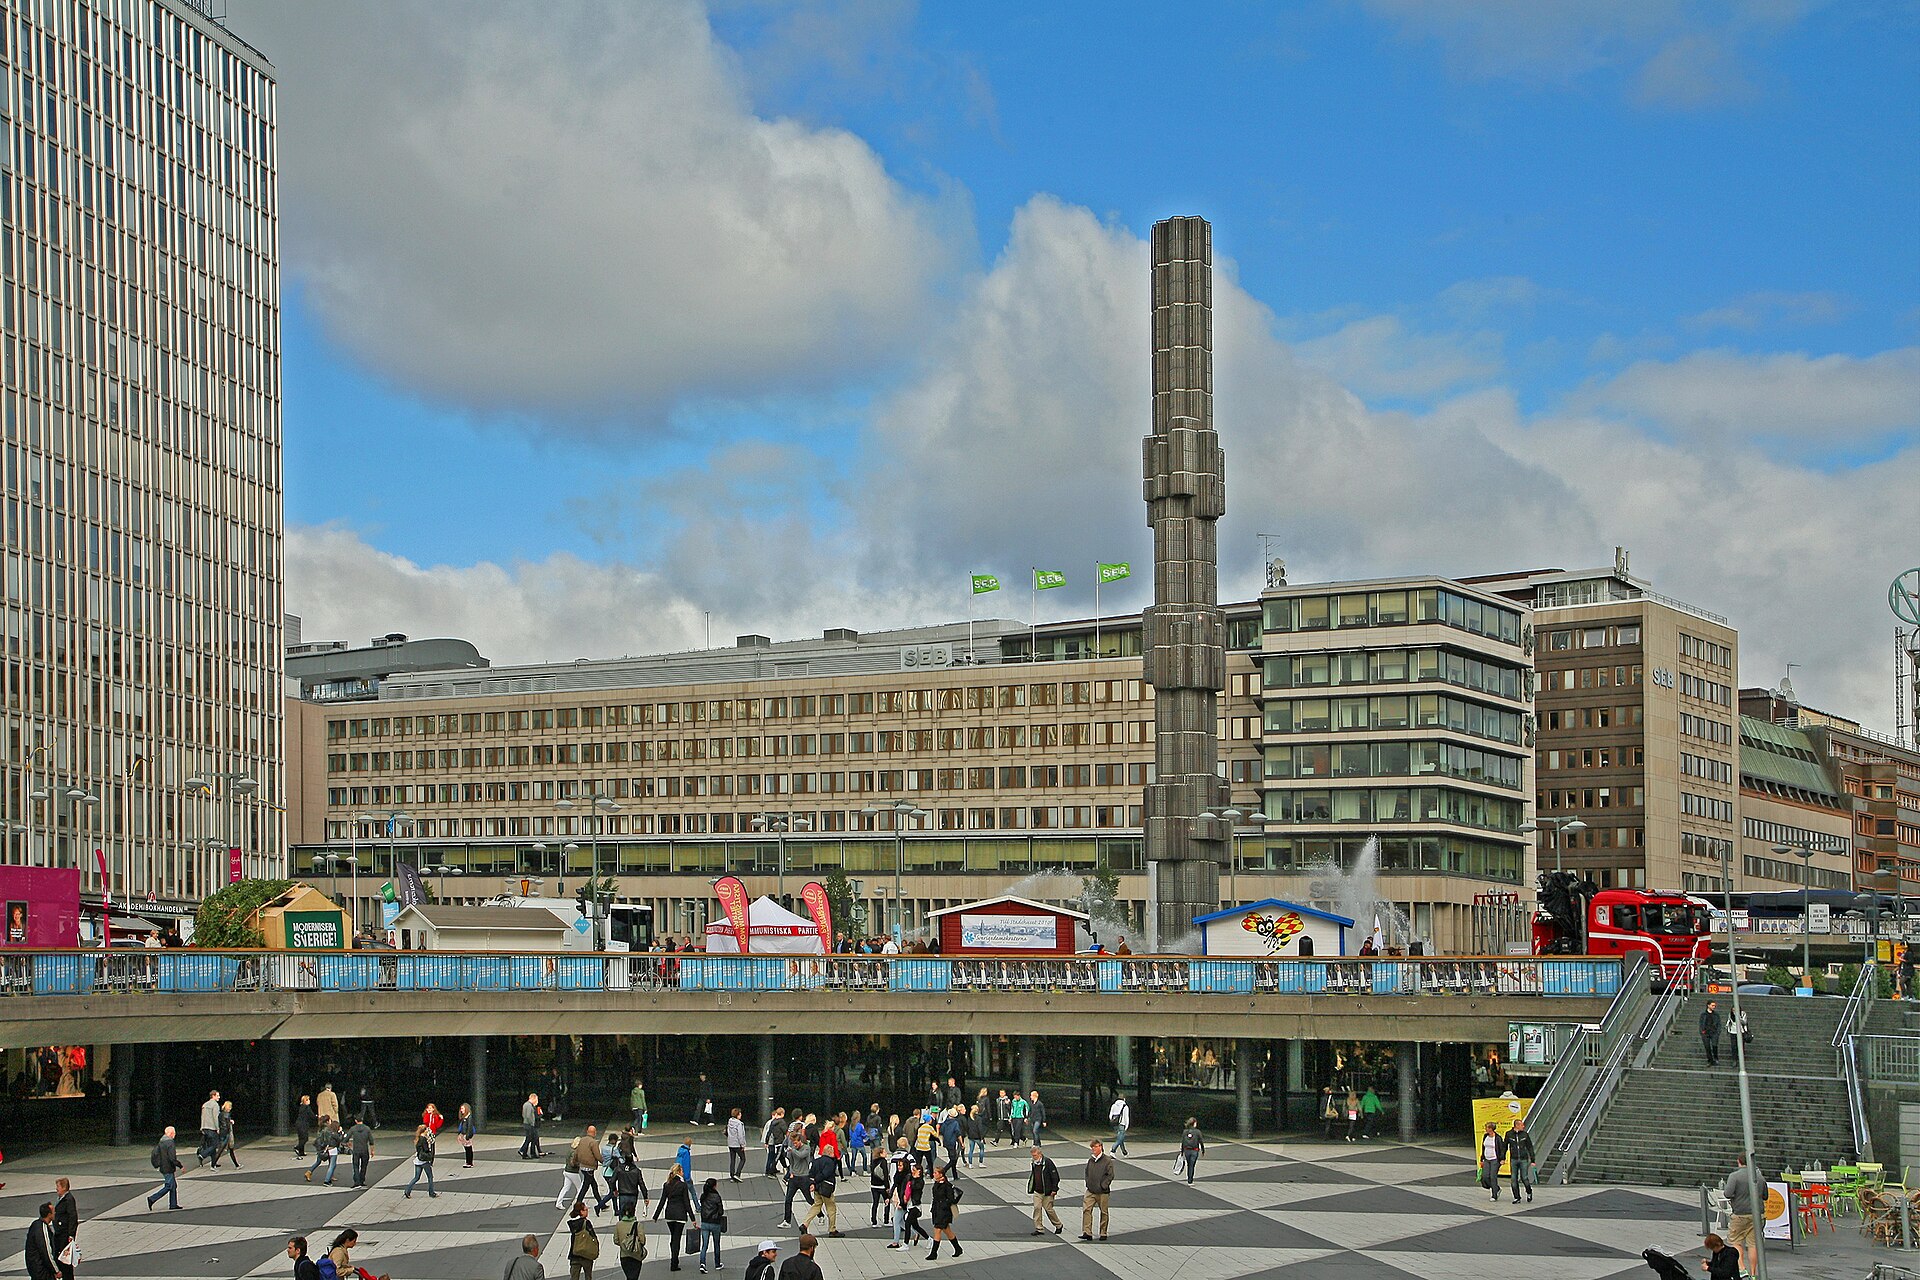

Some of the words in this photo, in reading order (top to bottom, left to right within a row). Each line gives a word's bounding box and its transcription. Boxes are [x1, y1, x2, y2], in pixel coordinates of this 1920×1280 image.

[1103, 566, 1127, 577] SEB
[1039, 572, 1063, 583] SEB
[975, 579, 997, 588] SEB
[904, 647, 948, 668] SEB
[1653, 667, 1675, 689] SEB
[293, 922, 337, 934] MODERNISERA
[750, 927, 792, 935] MMUNISTISKA
[798, 927, 819, 935] PARTIE
[294, 932, 337, 947] SVERIGE!
